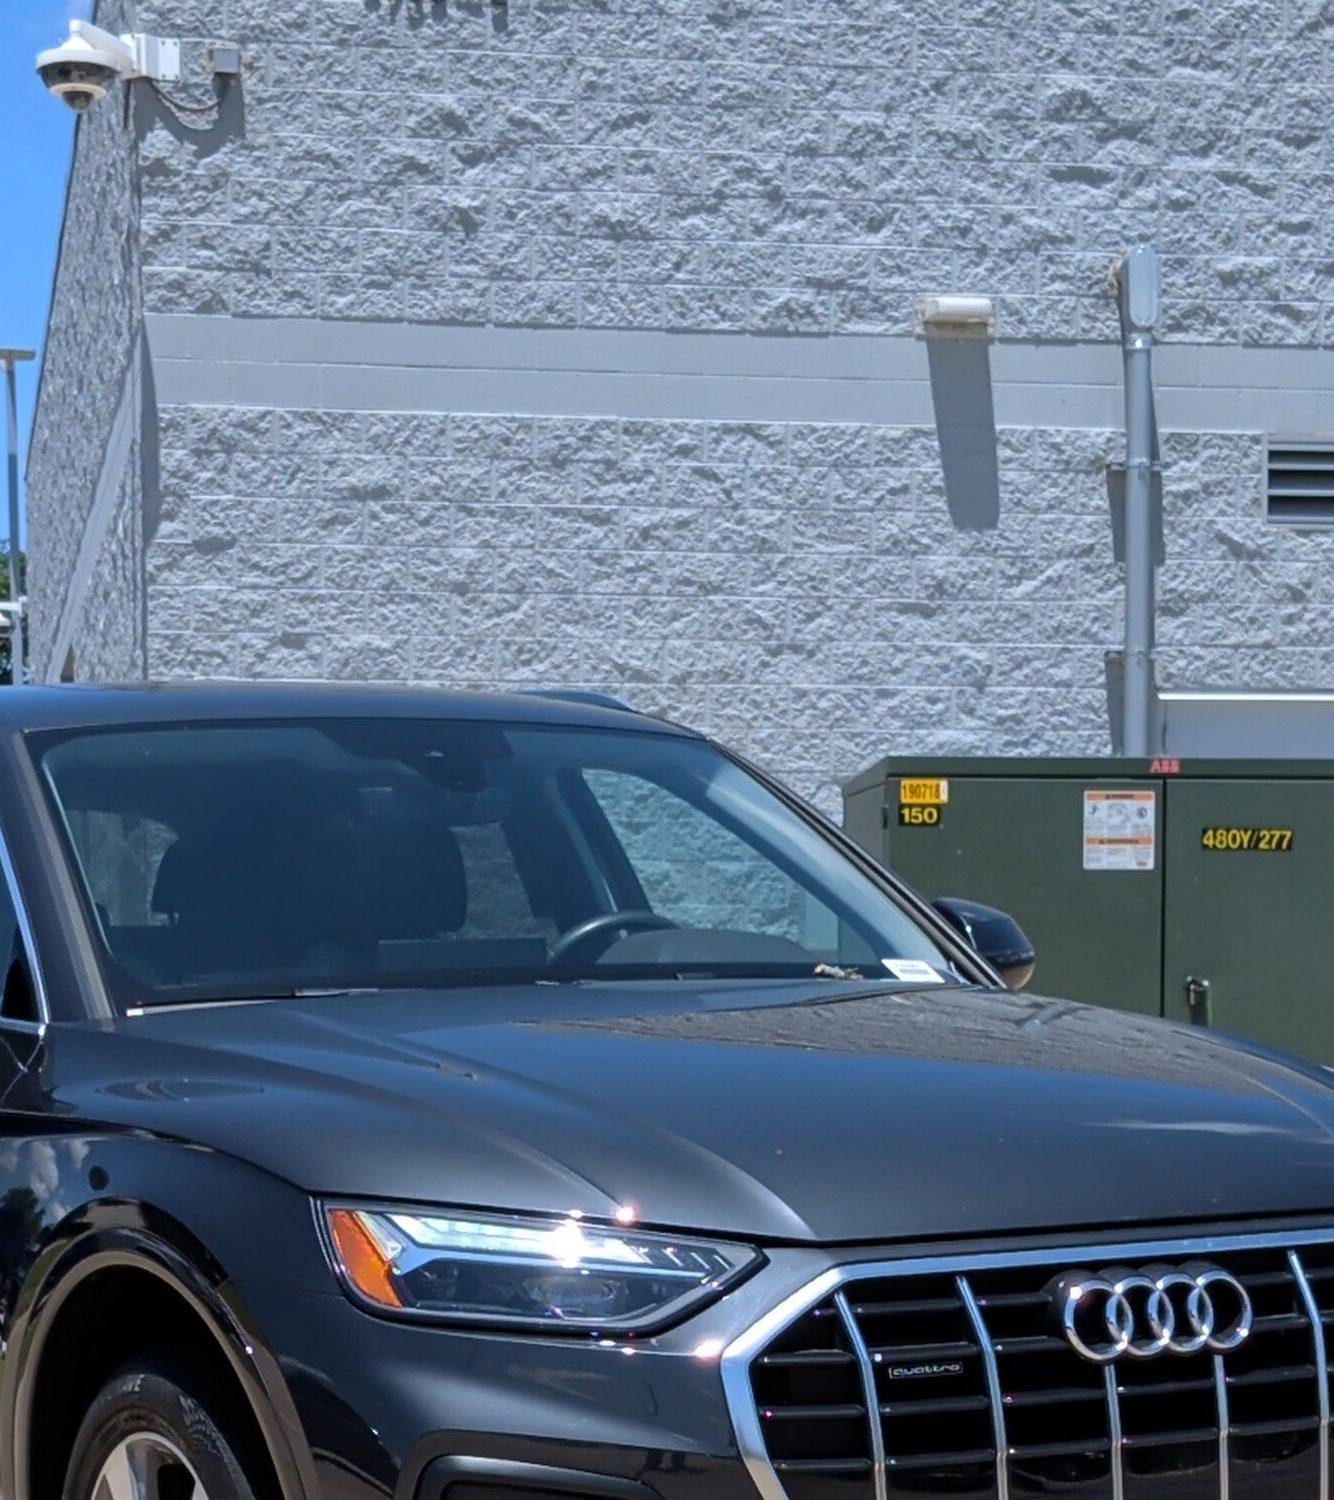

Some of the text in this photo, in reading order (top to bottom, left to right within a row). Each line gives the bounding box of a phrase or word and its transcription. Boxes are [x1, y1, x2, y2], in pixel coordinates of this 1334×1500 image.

[901, 807, 938, 824] 150
[1203, 829, 1292, 850] 480Y/277
[892, 1363, 961, 1377] quattro
